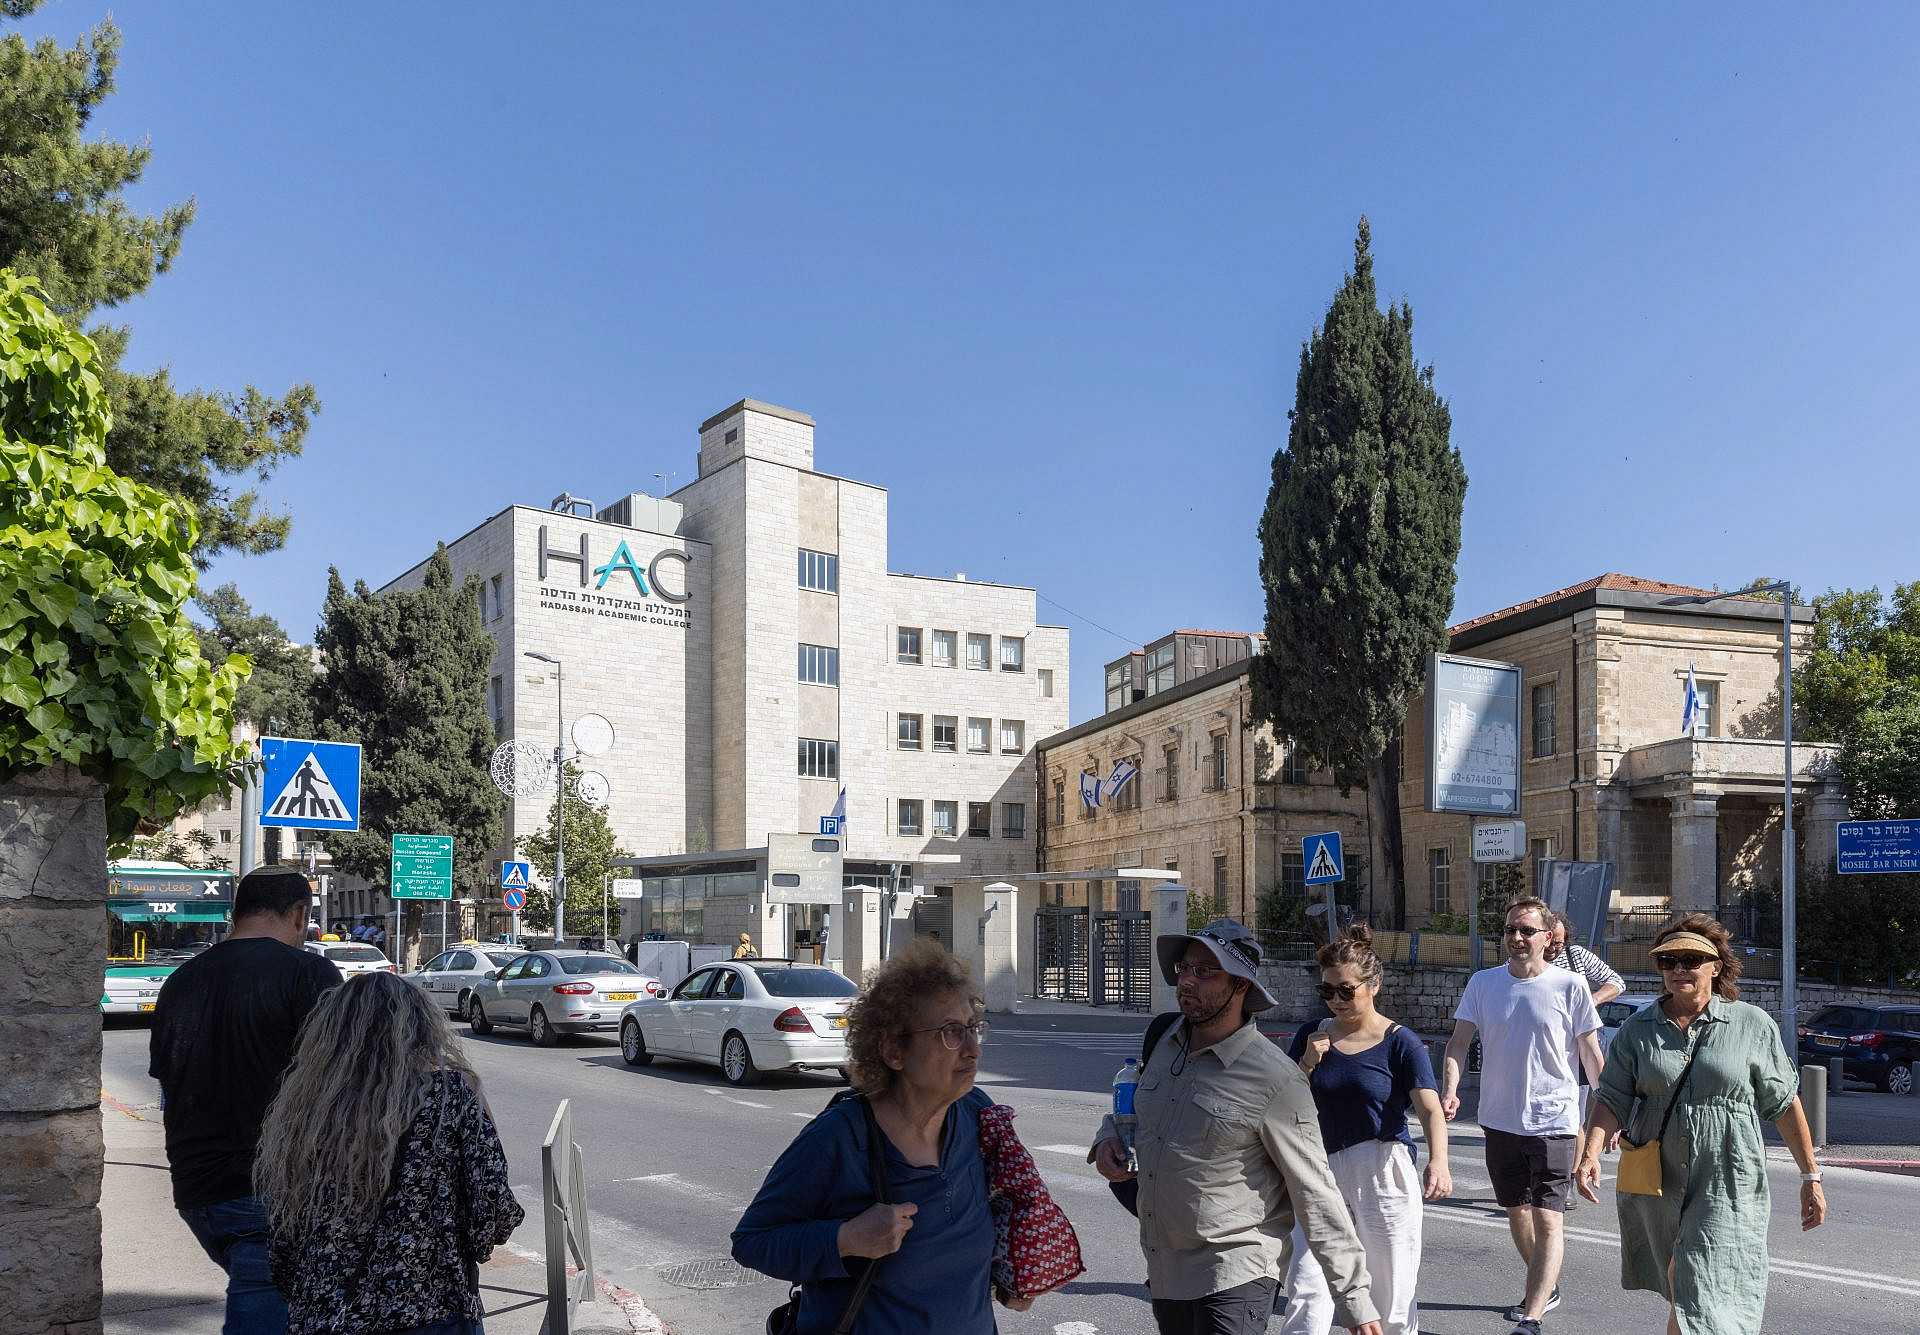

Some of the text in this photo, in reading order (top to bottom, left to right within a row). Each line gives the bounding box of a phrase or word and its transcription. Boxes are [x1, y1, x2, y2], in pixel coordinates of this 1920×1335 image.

[538, 525, 693, 604] HAC
[540, 587, 692, 618] המכללה האקדמית הדסה
[540, 600, 692, 629] HADASSAH ACADEMIC COLLEGE
[1451, 773, 1502, 785] 02-6744800
[1841, 859, 1917, 869] MOSHE BAR NISIM
